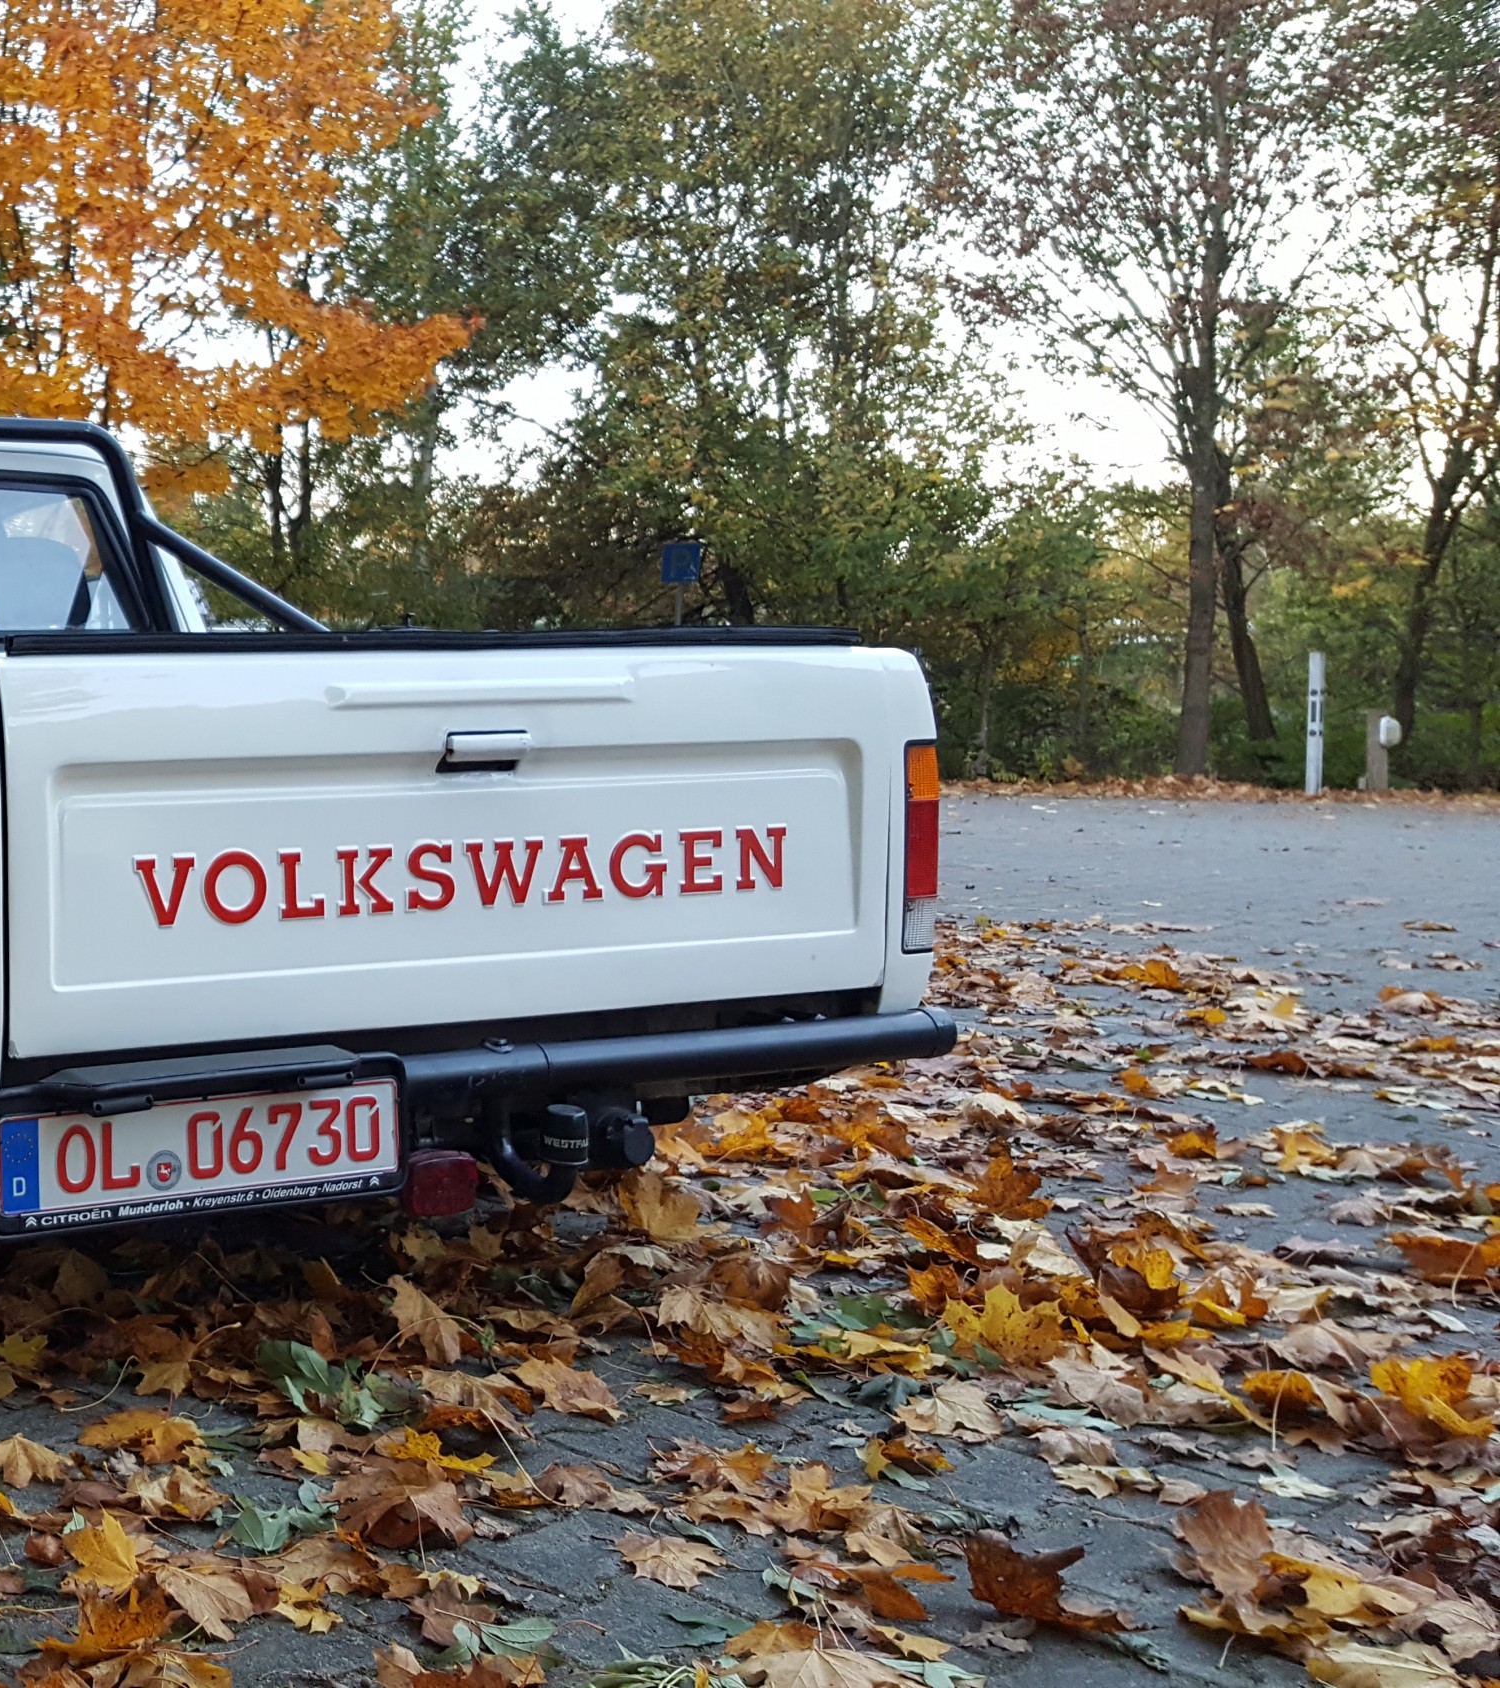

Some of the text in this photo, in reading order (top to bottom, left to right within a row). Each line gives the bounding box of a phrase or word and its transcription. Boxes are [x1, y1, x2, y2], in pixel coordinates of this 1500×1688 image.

[132, 823, 788, 927] VOLKSWAGEN
[56, 1095, 381, 1194] OL 06730
[12, 1176, 27, 1197] D
[118, 1199, 184, 1217] Munderloh
[261, 1178, 363, 1201] Oldenburg-Nadorst
